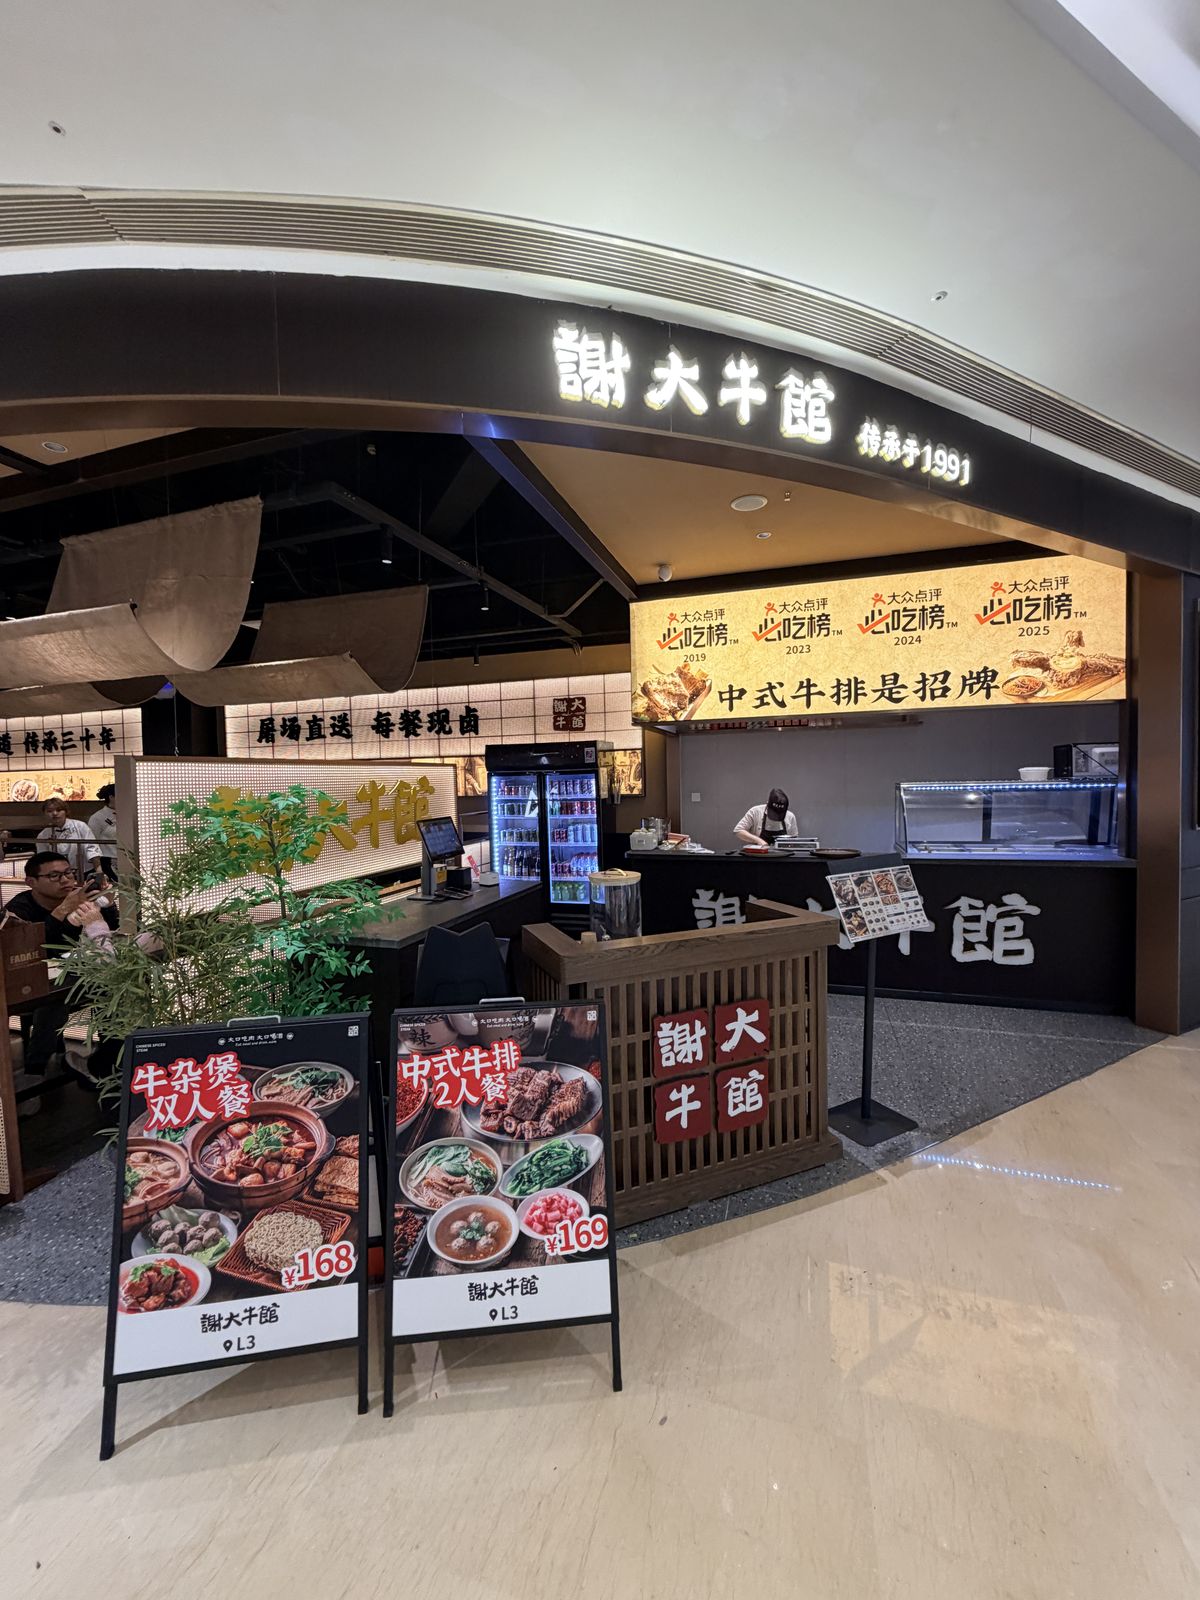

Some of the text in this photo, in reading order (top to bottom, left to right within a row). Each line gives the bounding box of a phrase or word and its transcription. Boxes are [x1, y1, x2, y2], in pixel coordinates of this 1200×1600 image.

[552, 320, 835, 444] 謝大牛館
[855, 418, 971, 487] 传承于1991
[888, 588, 943, 606] 大众点评
[1008, 575, 1070, 594] 大众点评
[680, 608, 726, 623] 大众点评
[779, 597, 829, 615] 大众点评
[857, 604, 946, 634] 必吃榜
[974, 592, 1074, 627] 必吃榜
[656, 622, 728, 651] 必吃榜
[752, 611, 831, 642] 必吃榜
[893, 634, 922, 647] 2024
[1018, 624, 1050, 637] 2025
[683, 652, 707, 663] 2019
[785, 644, 812, 655] 2023
[717, 665, 1000, 712] 中式牛排是招牌
[256, 705, 480, 744] 屠场直送 每餐现卤
[23, 726, 116, 754] 传承三十年
[134, 1054, 241, 1098] 牛杂煲
[401, 1042, 520, 1090] 中式牛排
[435, 1074, 508, 1106] 2人餐
[150, 1083, 251, 1128] 双人餐
[547, 1219, 607, 1253] ¥169
[284, 1243, 353, 1286] ¥168
[468, 1275, 538, 1301] 謝大牛館
[200, 1302, 281, 1334] 謝大牛館
[502, 1306, 518, 1320] L3
[237, 1336, 255, 1350] L3
